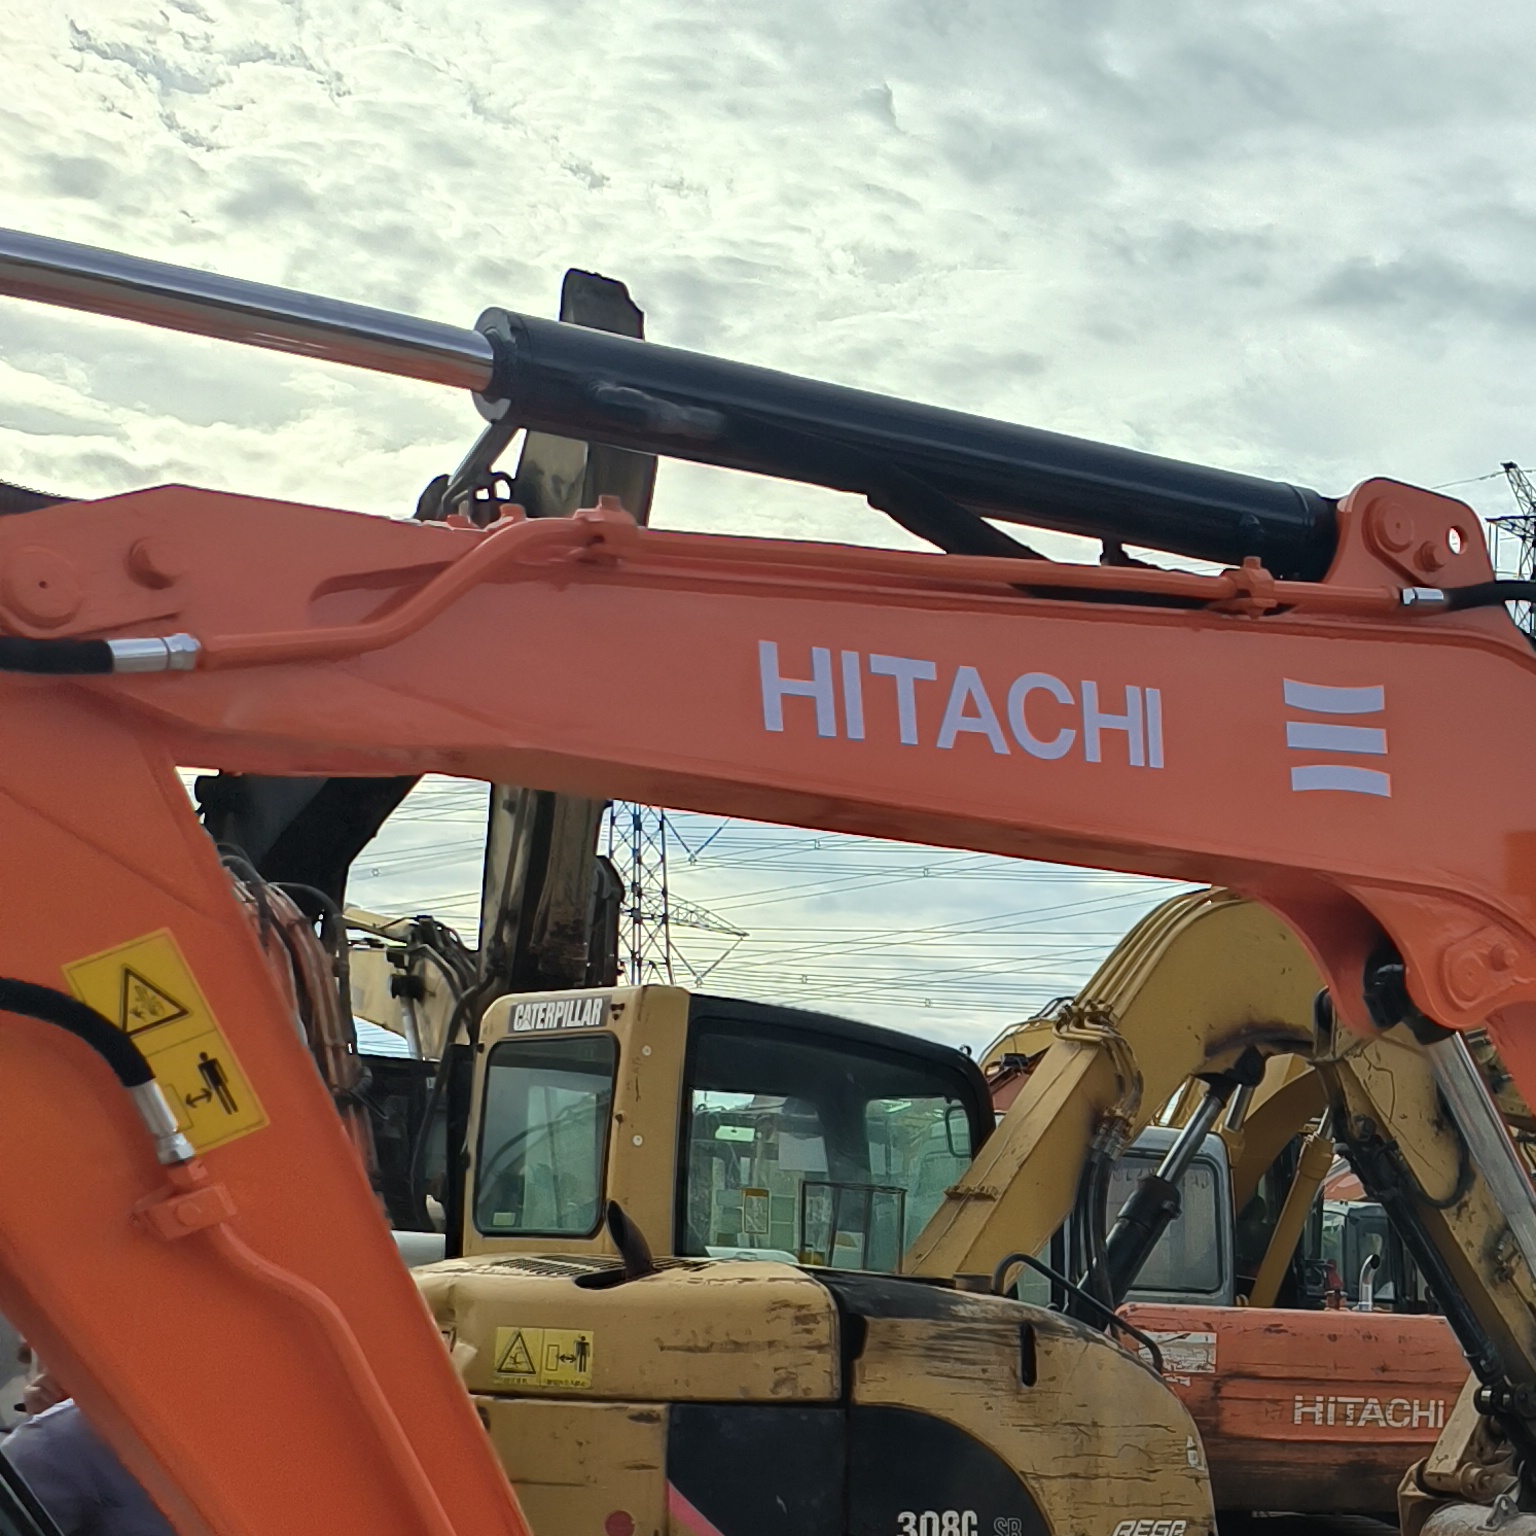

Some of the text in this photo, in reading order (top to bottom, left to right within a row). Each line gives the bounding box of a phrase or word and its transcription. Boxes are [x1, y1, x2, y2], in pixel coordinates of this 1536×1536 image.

[757, 639, 1166, 769] HITACHI
[513, 998, 603, 1031] CATERPILLAR
[1293, 1394, 1445, 1429] HITACHI
